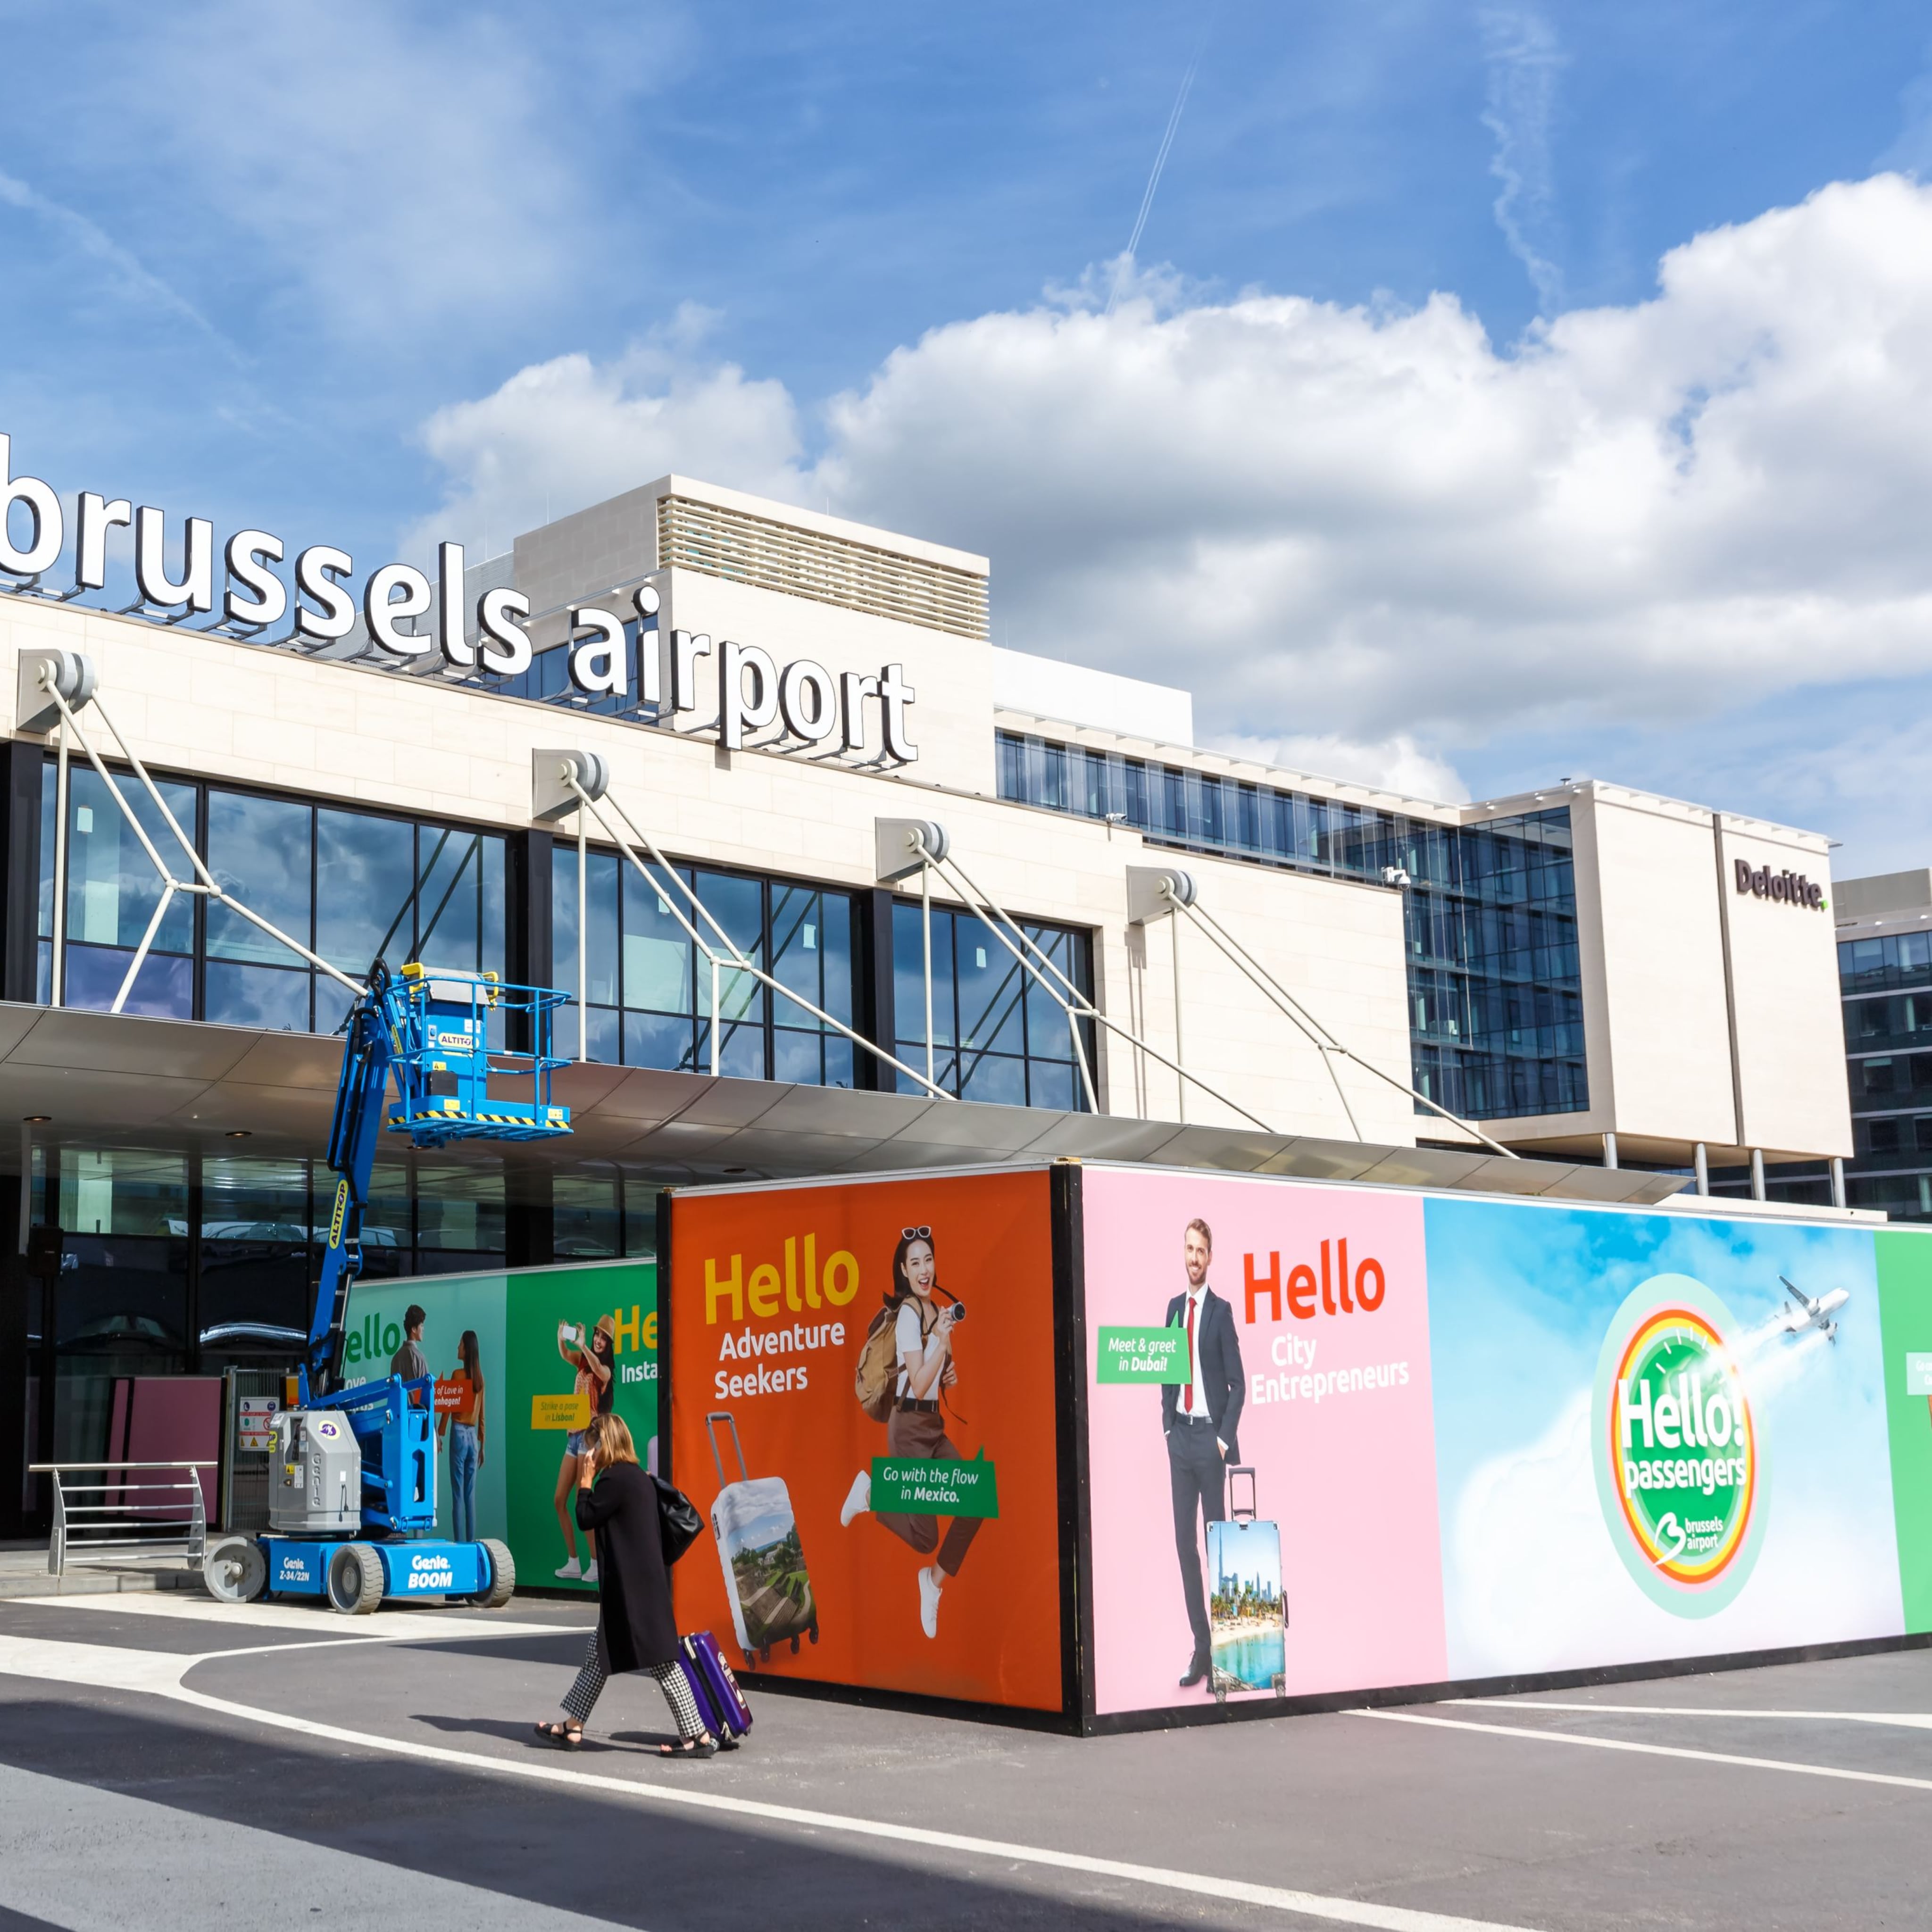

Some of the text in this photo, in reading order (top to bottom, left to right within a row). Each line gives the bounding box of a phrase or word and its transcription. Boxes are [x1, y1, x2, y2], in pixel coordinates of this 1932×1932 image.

[0, 433, 918, 762] brussels airport
[332, 1183, 345, 1245] ALTITOP
[704, 1232, 860, 1325] Hello
[1243, 1237, 1385, 1324] Hello
[346, 1312, 400, 1363] ello
[719, 1322, 845, 1361] Adventure
[1108, 1337, 1176, 1356] Meet & greet
[1271, 1332, 1317, 1370] City
[1119, 1356, 1168, 1372] in Dubai!
[437, 1385, 444, 1396] of
[444, 1386, 457, 1395] Love
[458, 1385, 463, 1394] in
[715, 1363, 808, 1399] Seekers
[1251, 1361, 1410, 1405] Entrepreneurs
[434, 1397, 461, 1407] enhagen!
[541, 1401, 558, 1411] Strike
[564, 1403, 579, 1411] pose
[1617, 1372, 1745, 1449] Hello!
[551, 1412, 575, 1422] Lisbon!
[883, 1466, 979, 1487] Go with the flow
[1623, 1457, 1747, 1499] passengers
[901, 1485, 959, 1503] in Mexico.
[1684, 1516, 1724, 1534] brussels
[1687, 1533, 1718, 1552] airport
[283, 1557, 304, 1569] Genie
[408, 1572, 453, 1589] BOOM
